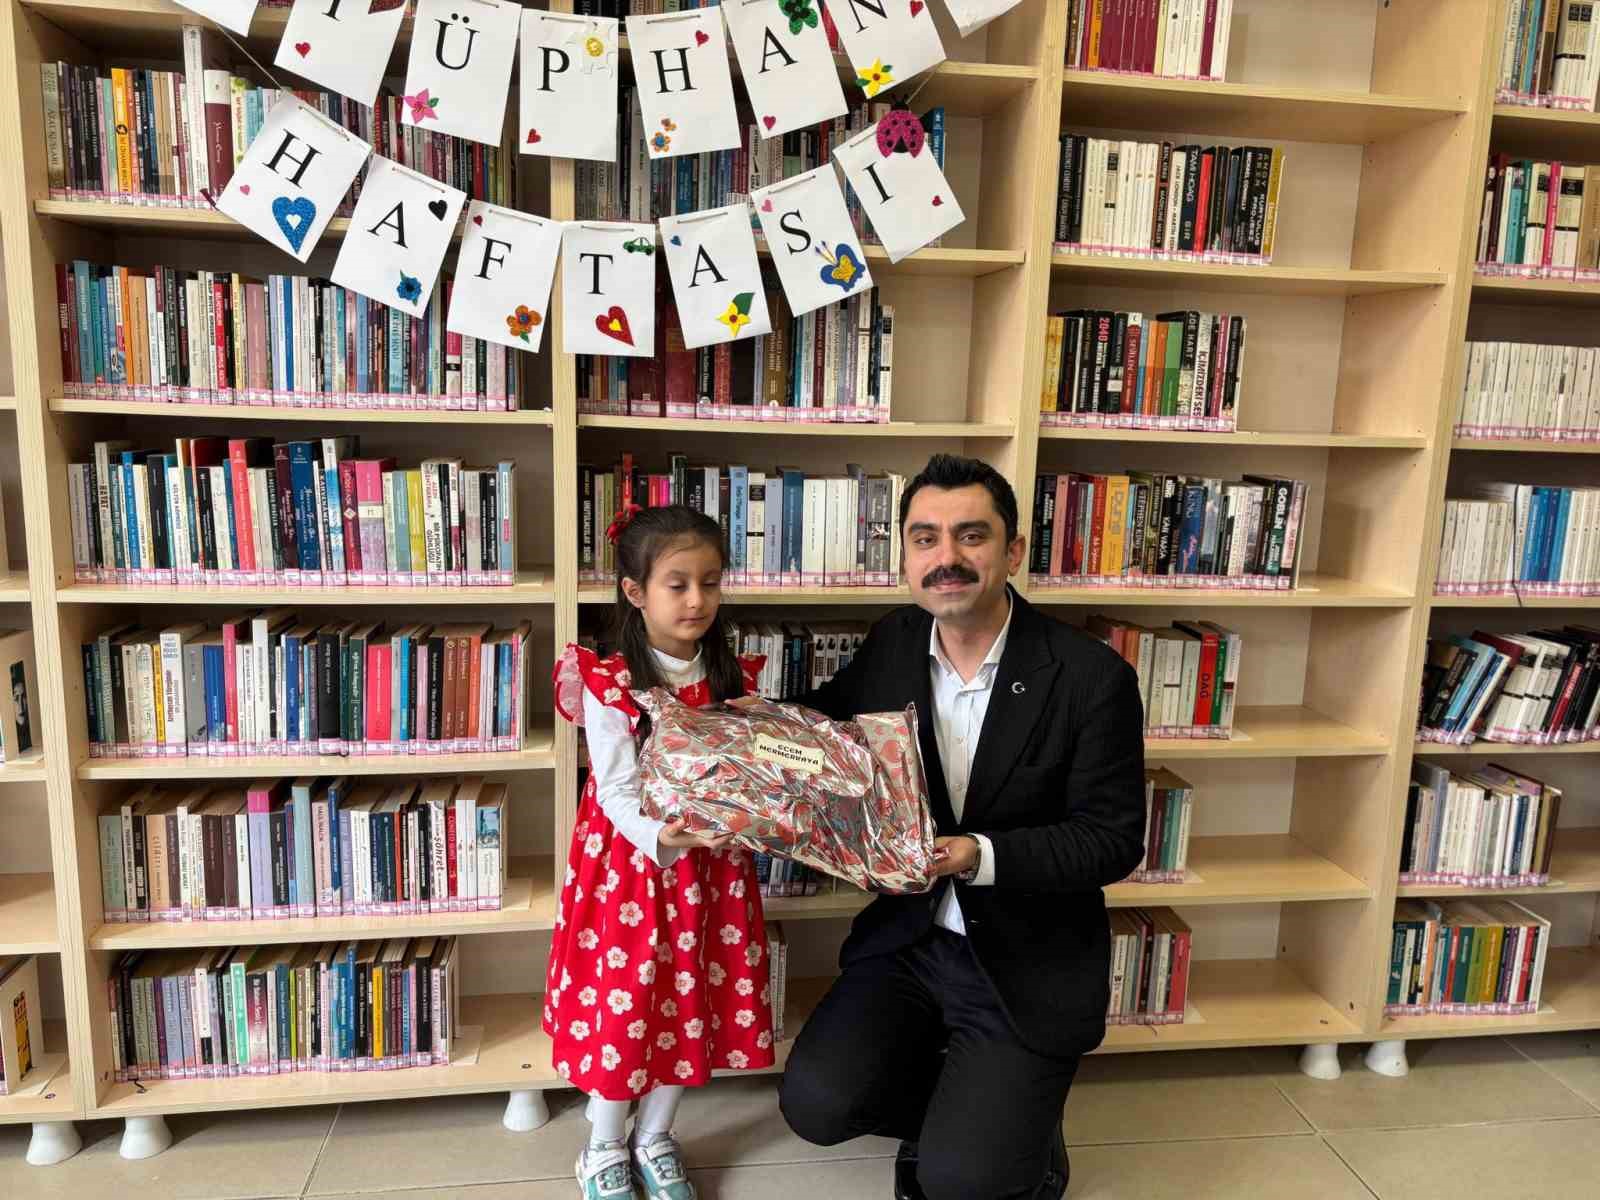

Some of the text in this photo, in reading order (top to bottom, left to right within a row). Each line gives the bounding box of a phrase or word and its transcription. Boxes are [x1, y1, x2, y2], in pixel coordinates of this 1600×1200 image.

[262, 128, 894, 296] HAFTASI
[1185, 313, 1197, 359] JOE HART
